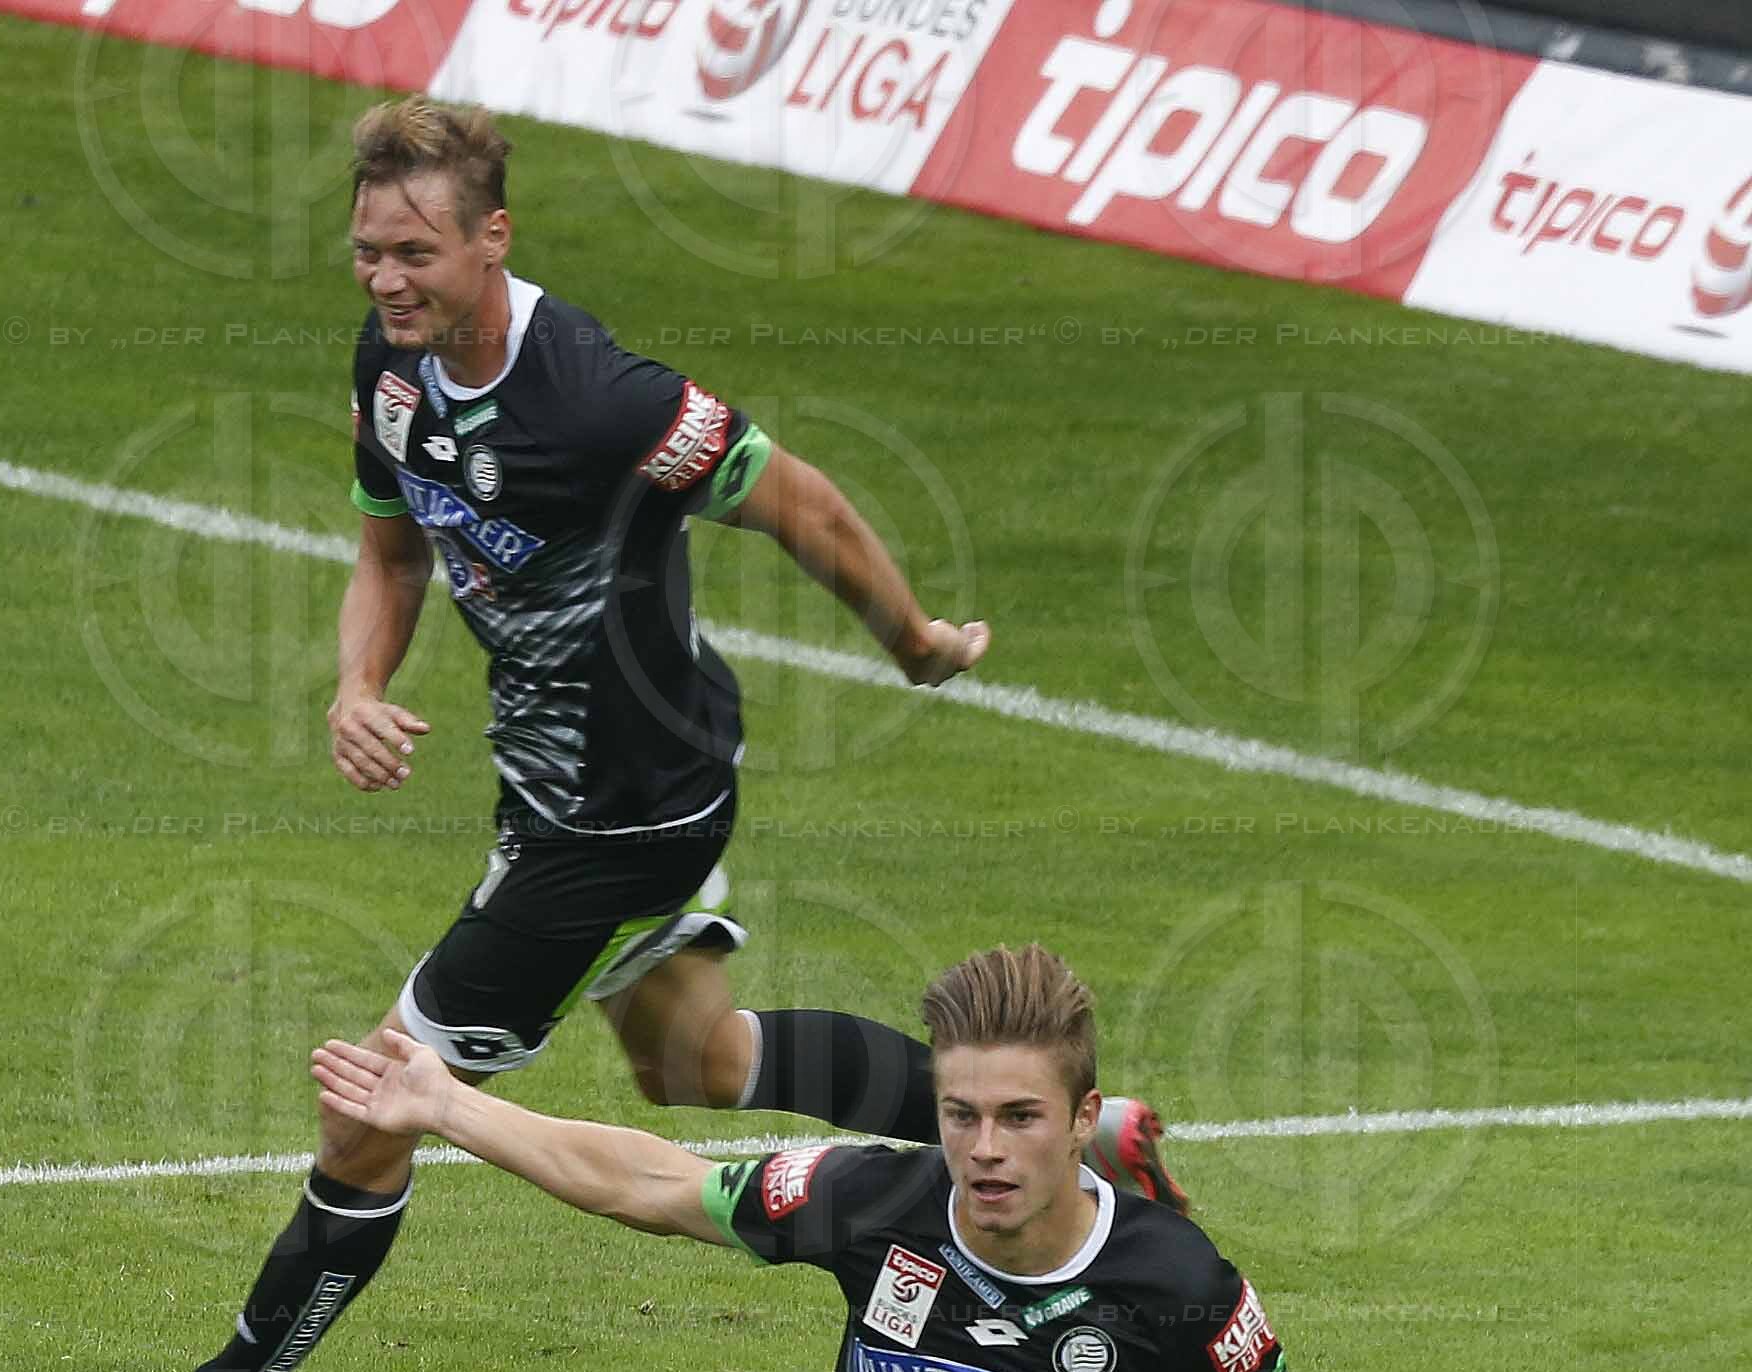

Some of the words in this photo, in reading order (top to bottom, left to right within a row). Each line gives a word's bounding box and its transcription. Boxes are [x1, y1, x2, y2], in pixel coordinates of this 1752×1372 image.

[785, 27, 951, 130] LIGA
[1011, 0, 1428, 244] tipico
[1492, 150, 1686, 261] tipico
[872, 1307, 914, 1339] LIGA
